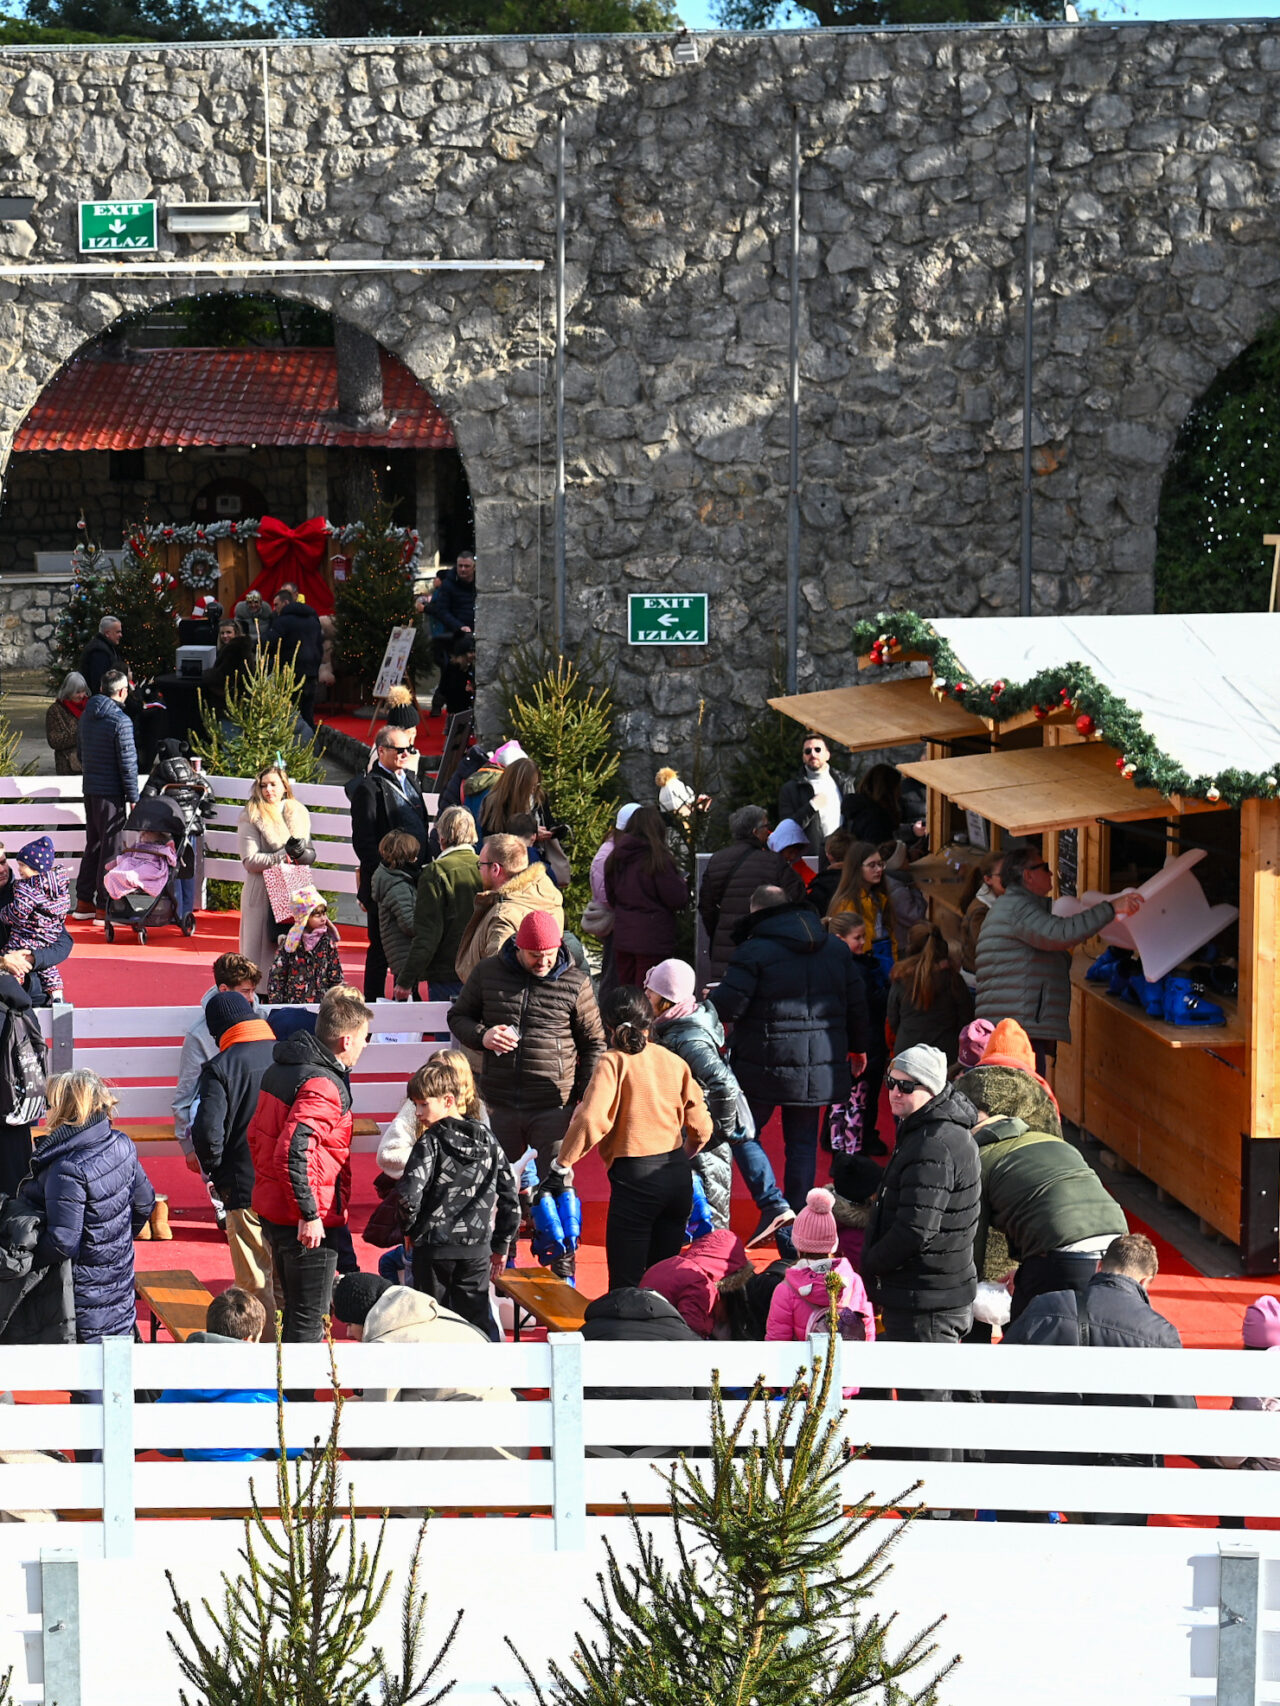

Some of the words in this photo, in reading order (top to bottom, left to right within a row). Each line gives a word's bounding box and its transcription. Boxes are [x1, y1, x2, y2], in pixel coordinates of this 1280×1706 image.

[93, 204, 143, 216] EXIT
[89, 236, 149, 248] IZLAZ
[643, 598, 694, 609] EXIT
[637, 630, 700, 641] IZLAZ
